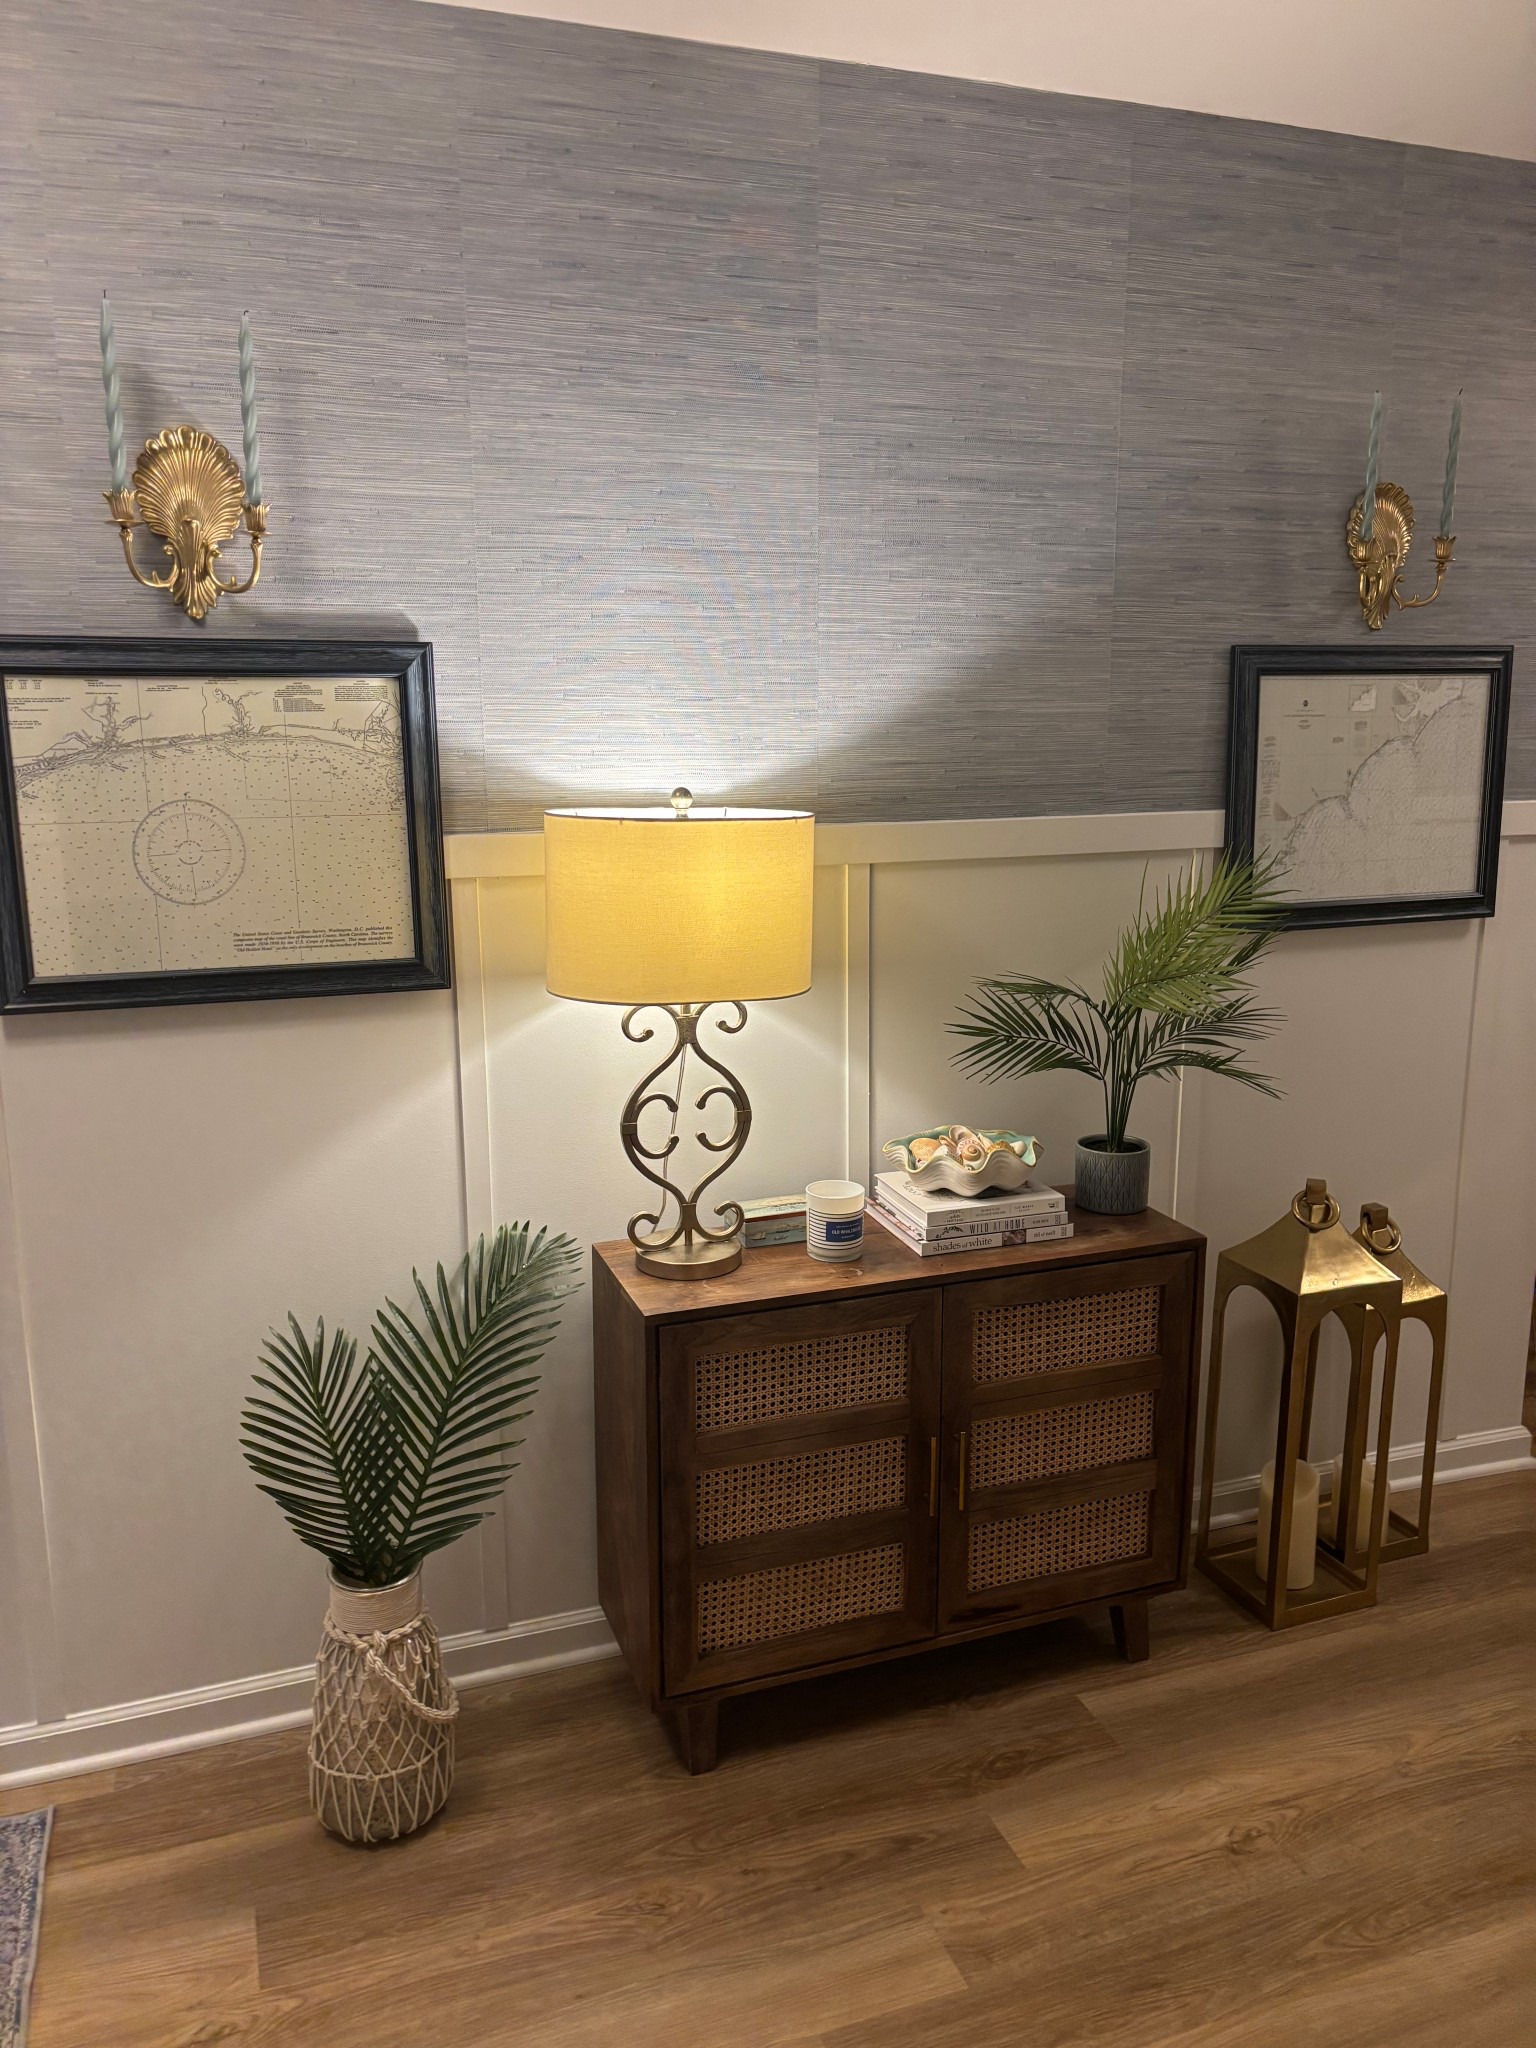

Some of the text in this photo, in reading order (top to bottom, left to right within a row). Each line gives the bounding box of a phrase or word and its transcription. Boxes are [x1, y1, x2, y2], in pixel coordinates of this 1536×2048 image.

[970, 1223, 989, 1234] WILD
[993, 1221, 1001, 1231] AT
[1005, 1219, 1025, 1229] HOME
[932, 1242, 961, 1252] shades
[969, 1238, 992, 1247] white
